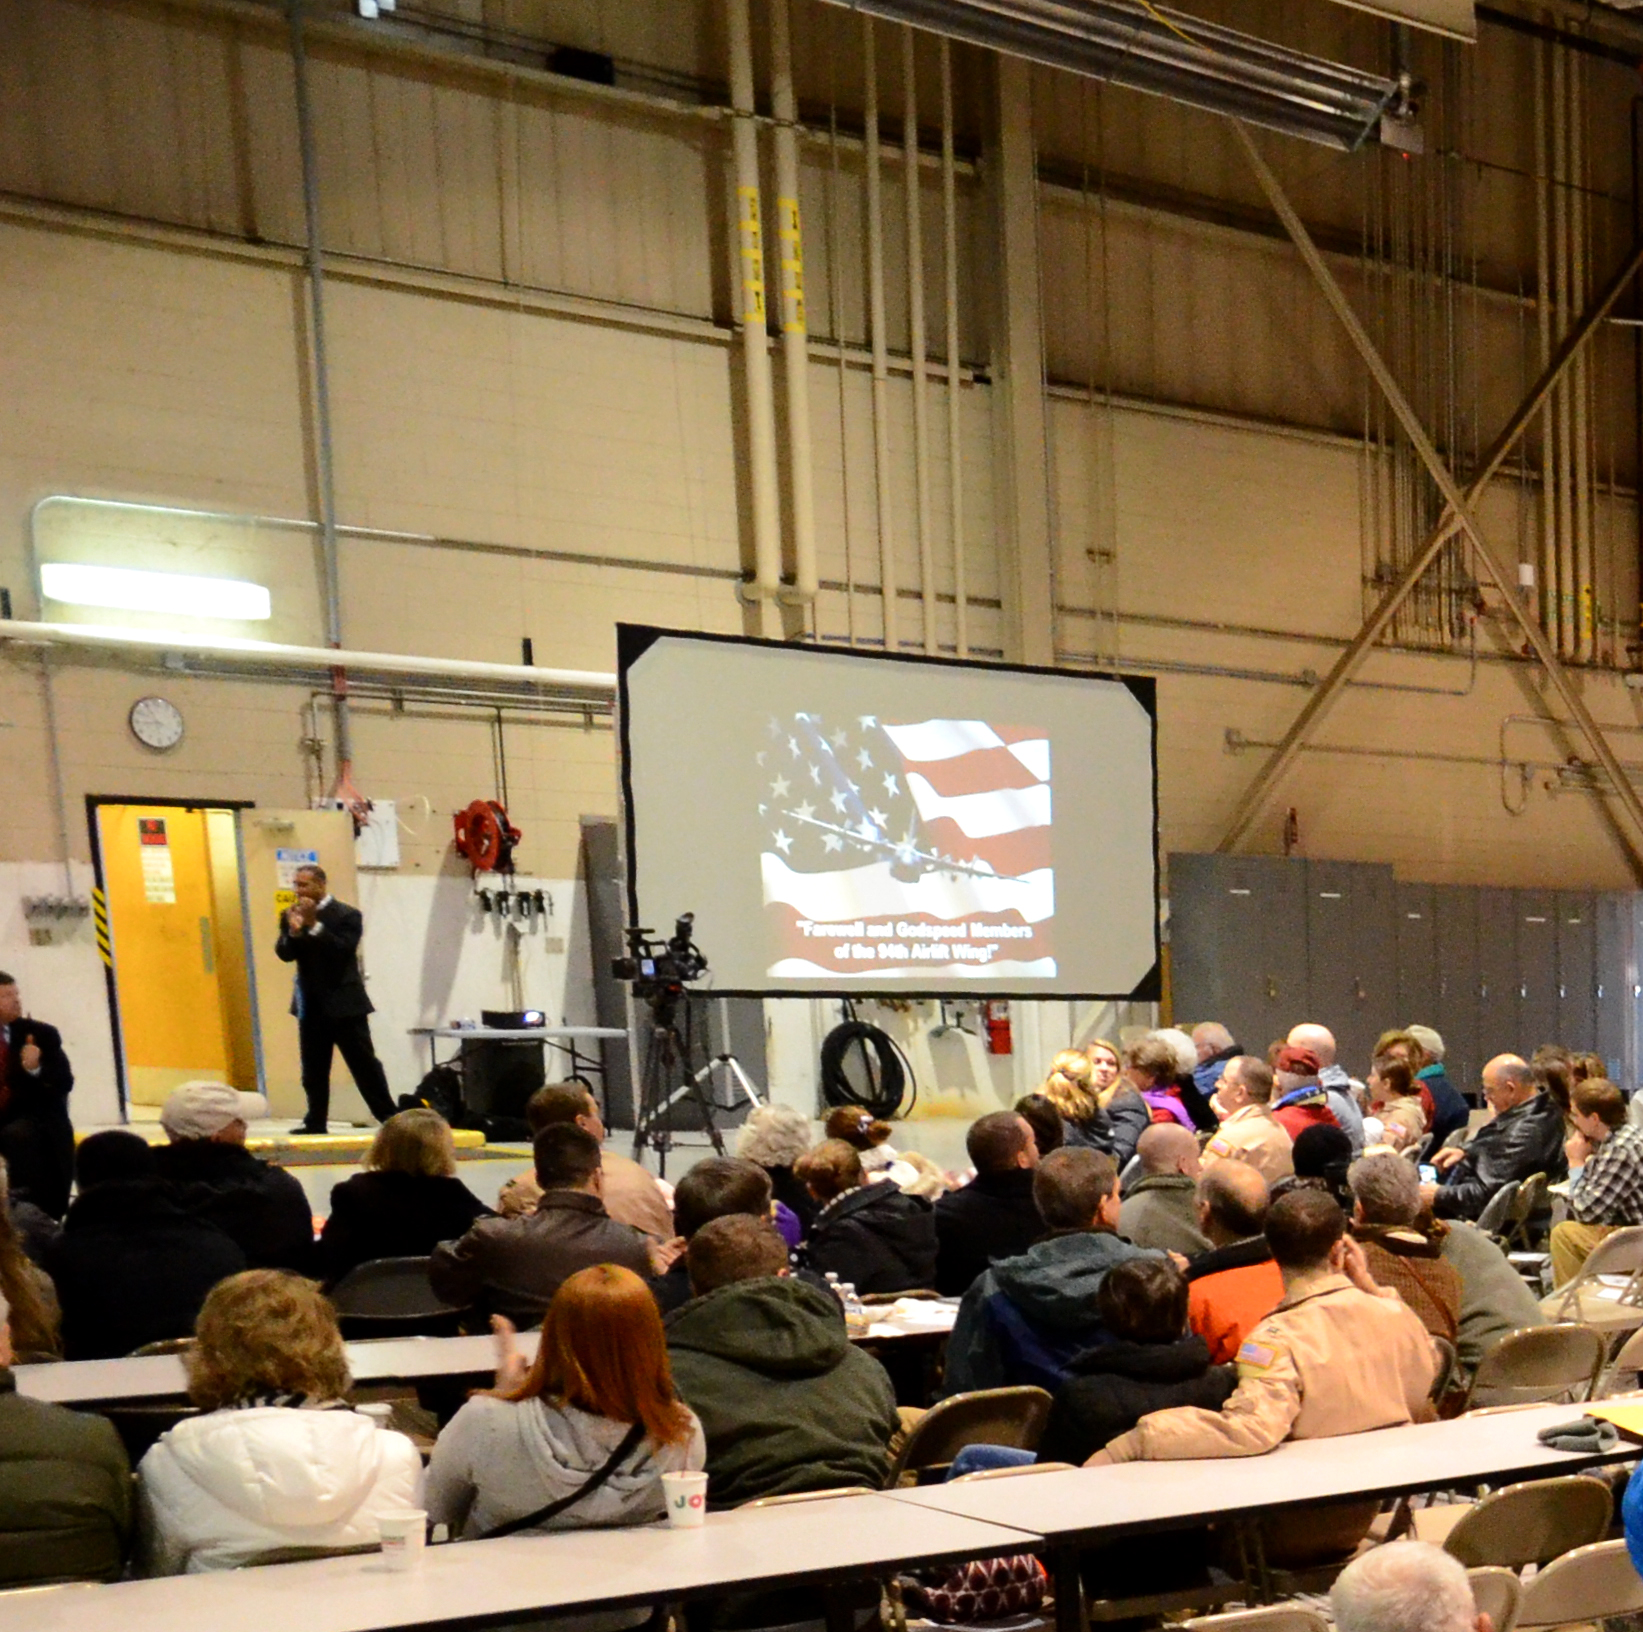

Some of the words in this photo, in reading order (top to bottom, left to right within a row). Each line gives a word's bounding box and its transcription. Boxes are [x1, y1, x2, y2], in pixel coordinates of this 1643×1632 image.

[866, 922, 893, 937] and
[896, 922, 966, 941] Godspeed
[970, 922, 1033, 938] Members
[834, 943, 852, 959] of
[852, 943, 875, 959] the
[877, 943, 909, 960] 94th
[911, 943, 950, 960] Airlift
[674, 1494, 703, 1509] JO
